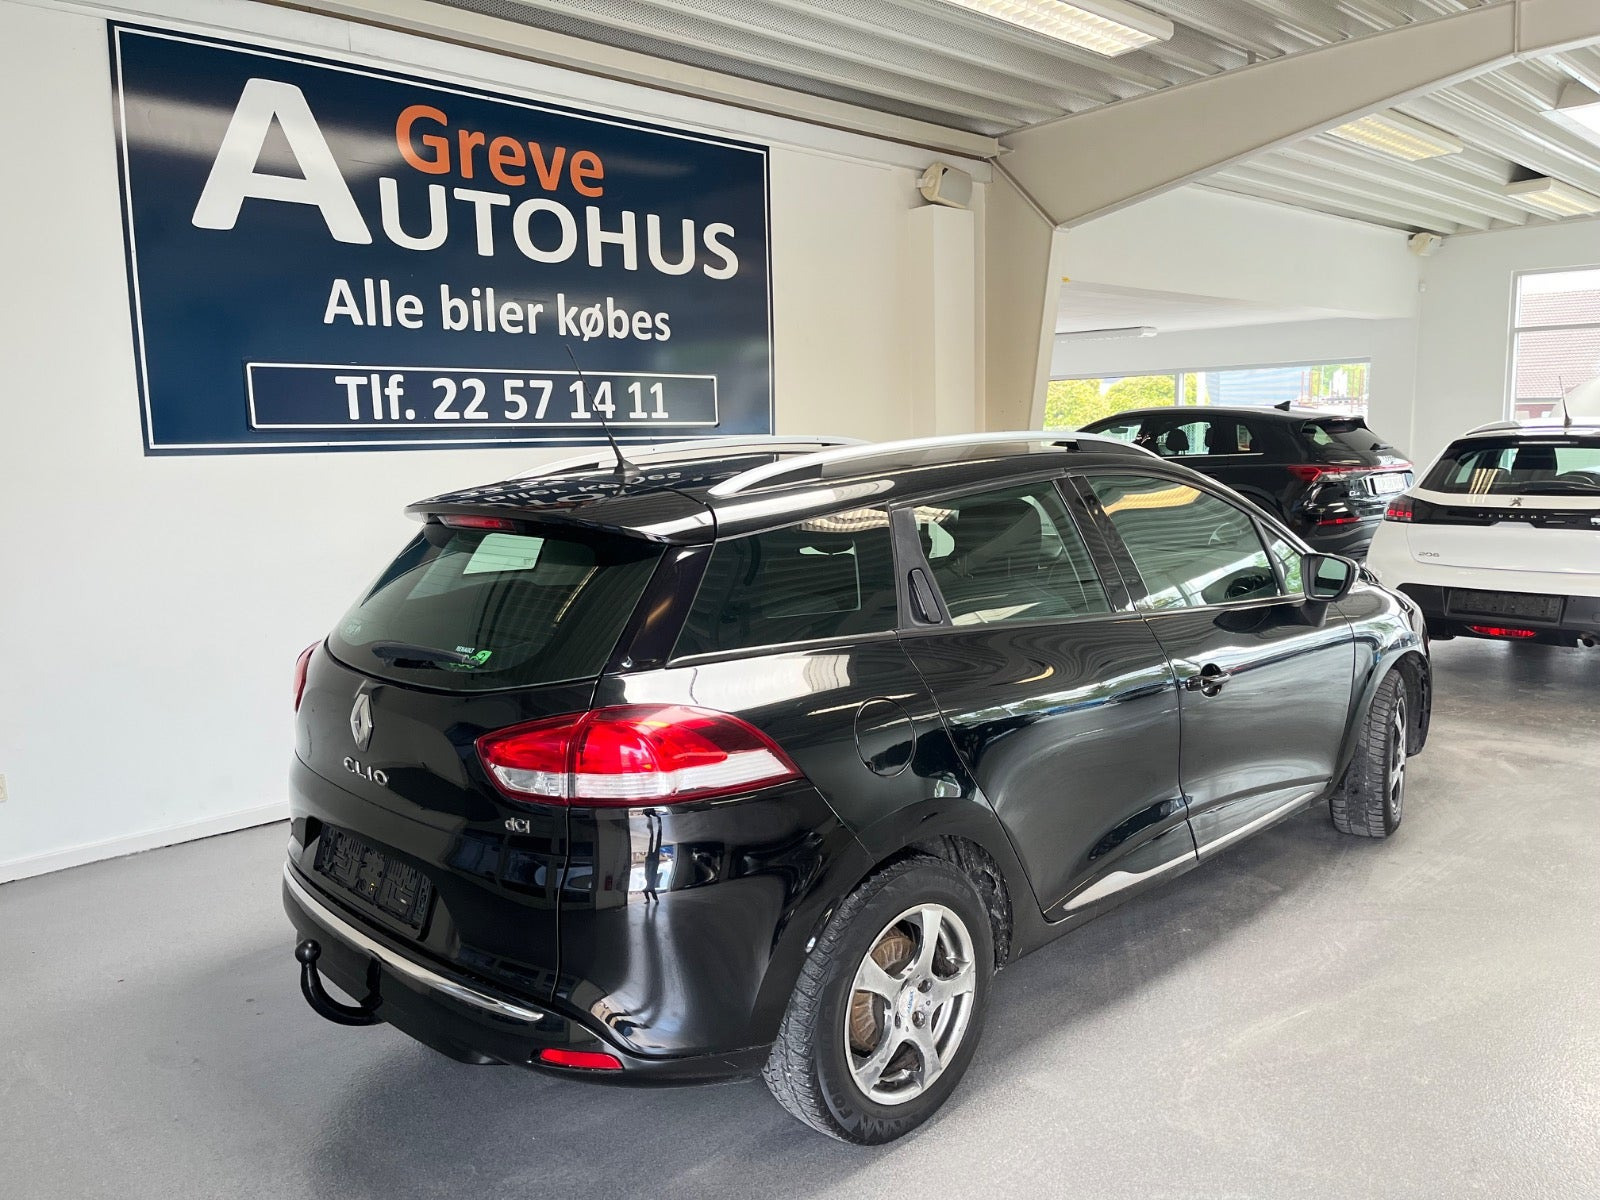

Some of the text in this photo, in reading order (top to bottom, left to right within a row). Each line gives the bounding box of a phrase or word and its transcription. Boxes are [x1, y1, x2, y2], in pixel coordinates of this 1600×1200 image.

[191, 77, 740, 281] AUTOHUS
[395, 104, 605, 198] Greve
[323, 278, 672, 343] Alle biler købes
[335, 375, 670, 421] Tlf. 22 57 14 11
[343, 756, 388, 786] CLIO
